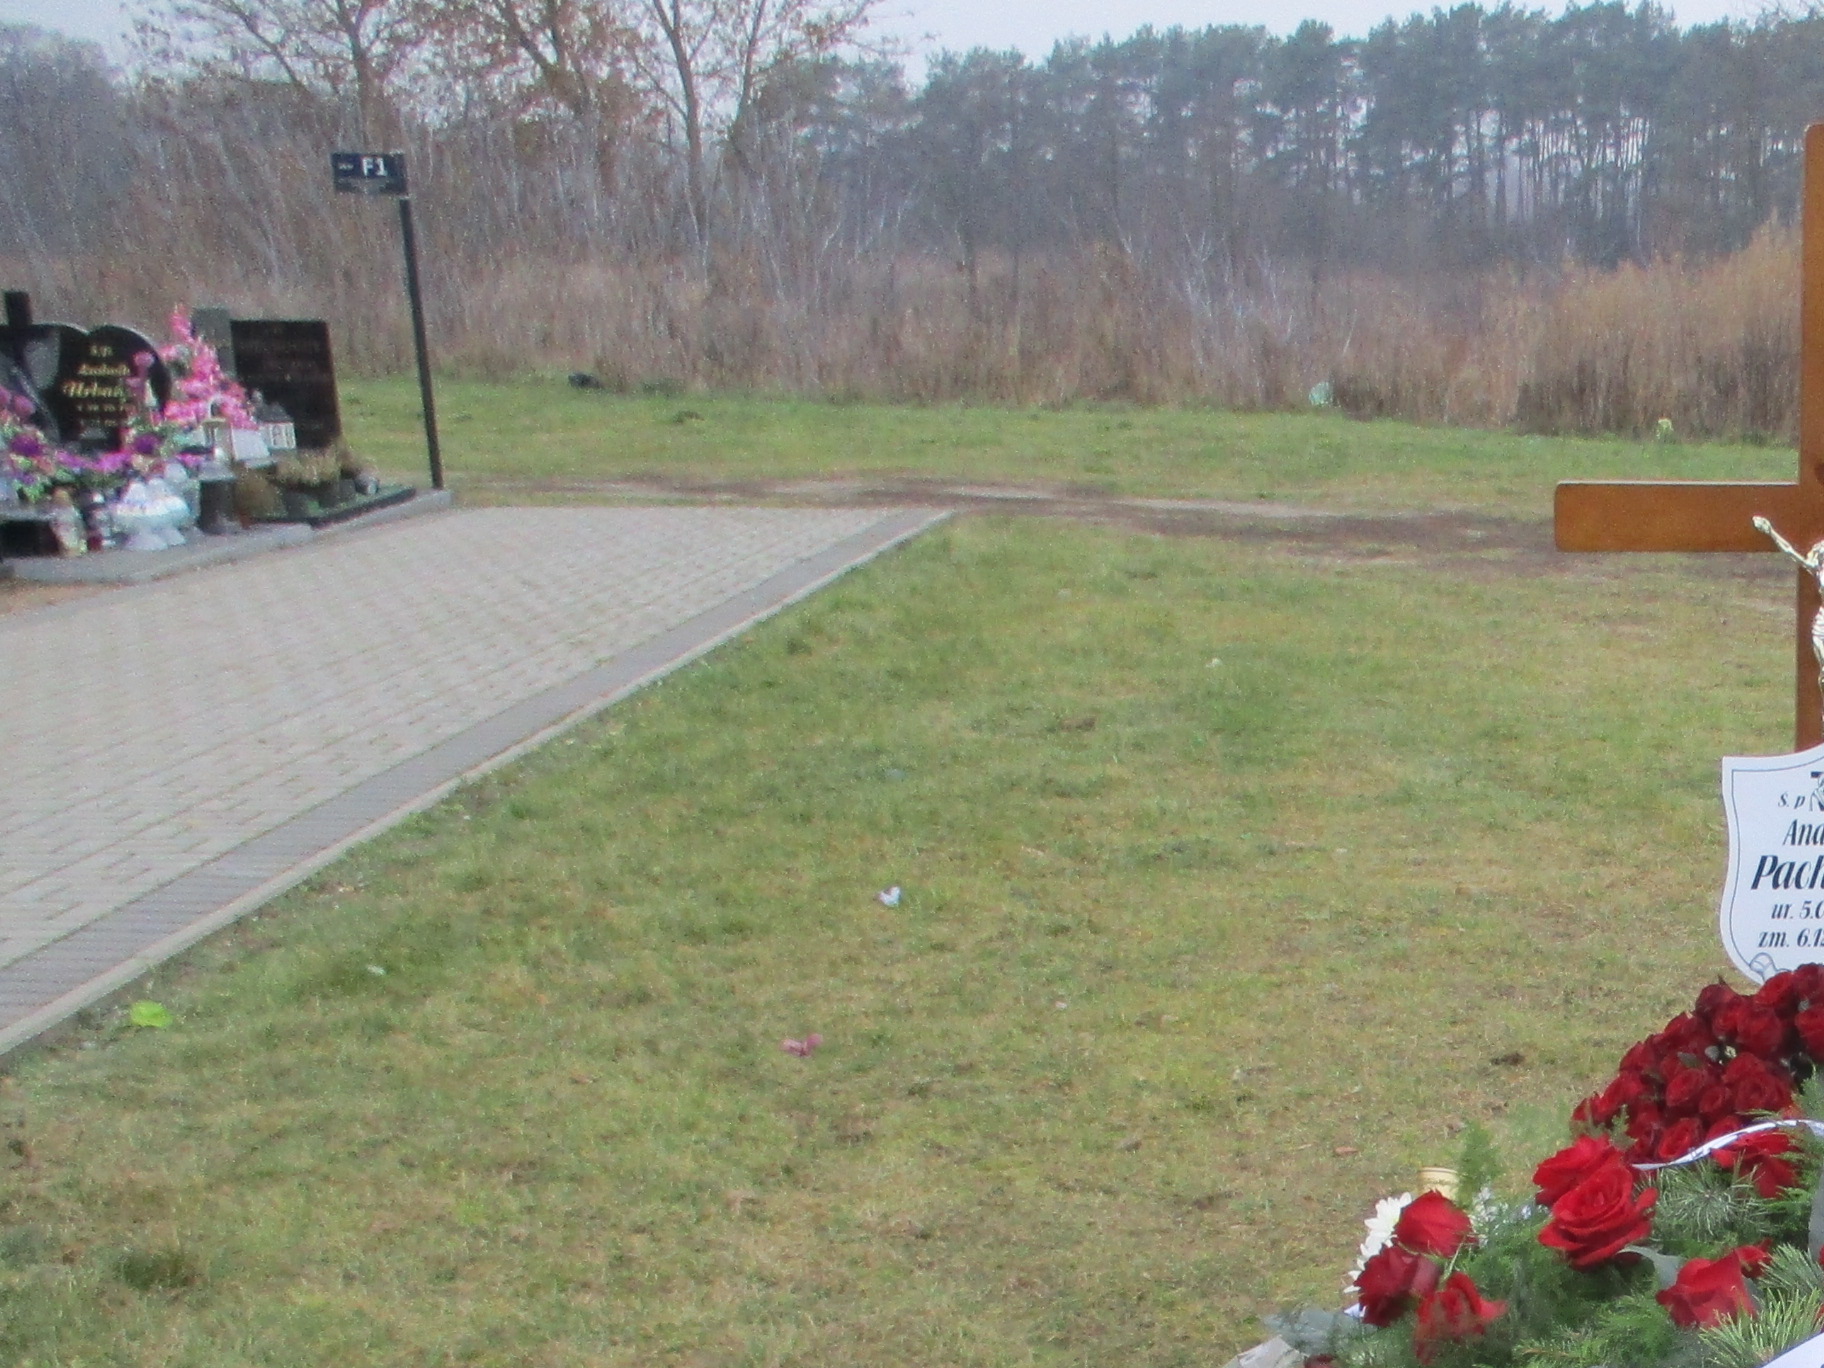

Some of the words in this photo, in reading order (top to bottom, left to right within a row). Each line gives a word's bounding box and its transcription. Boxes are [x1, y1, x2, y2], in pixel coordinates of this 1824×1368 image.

[362, 157, 388, 177] F1
[1771, 902, 1794, 919] ur.
[1758, 931, 1790, 948] zm.
